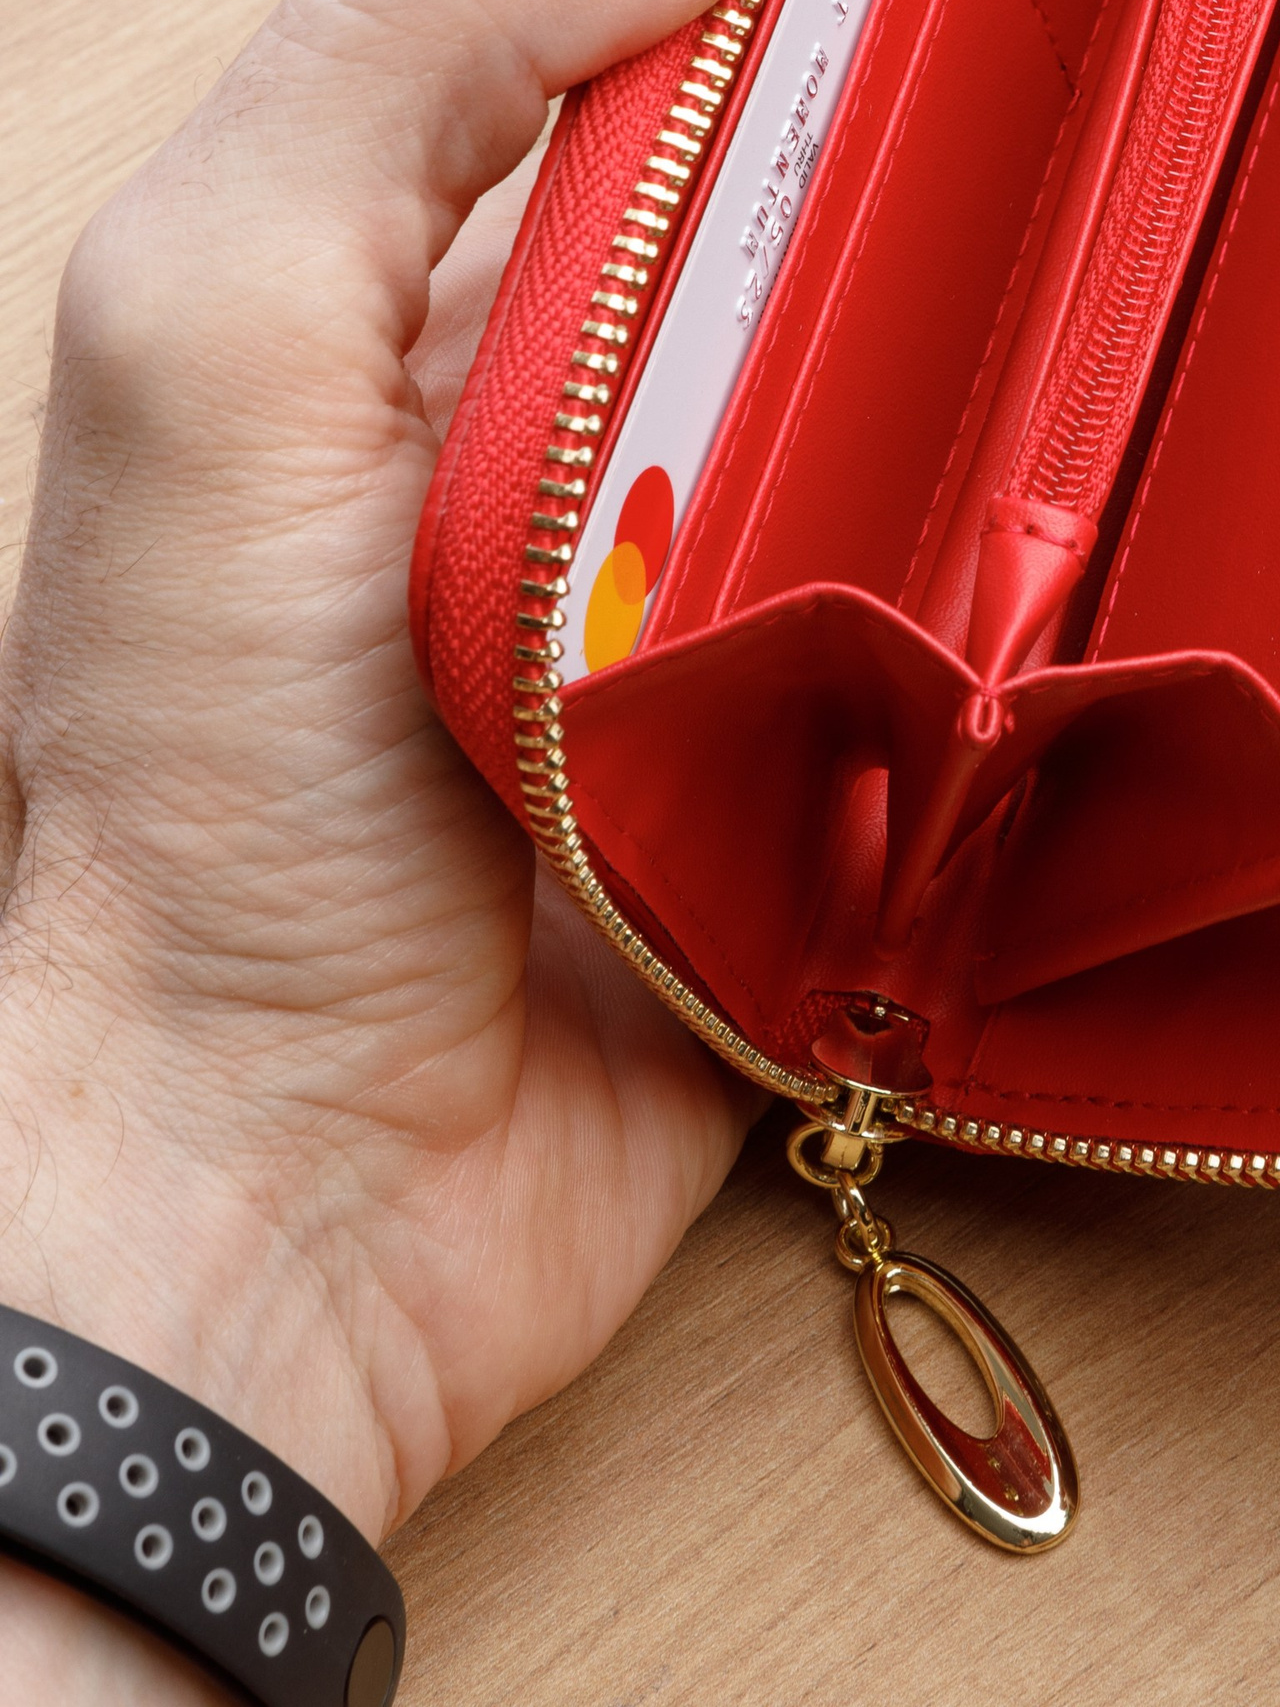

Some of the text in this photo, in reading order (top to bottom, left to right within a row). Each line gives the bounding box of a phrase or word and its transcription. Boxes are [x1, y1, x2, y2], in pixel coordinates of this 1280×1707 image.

[741, 42, 829, 261] MOMENTUM
[794, 131, 814, 178] THRU
[798, 141, 819, 190] VALID
